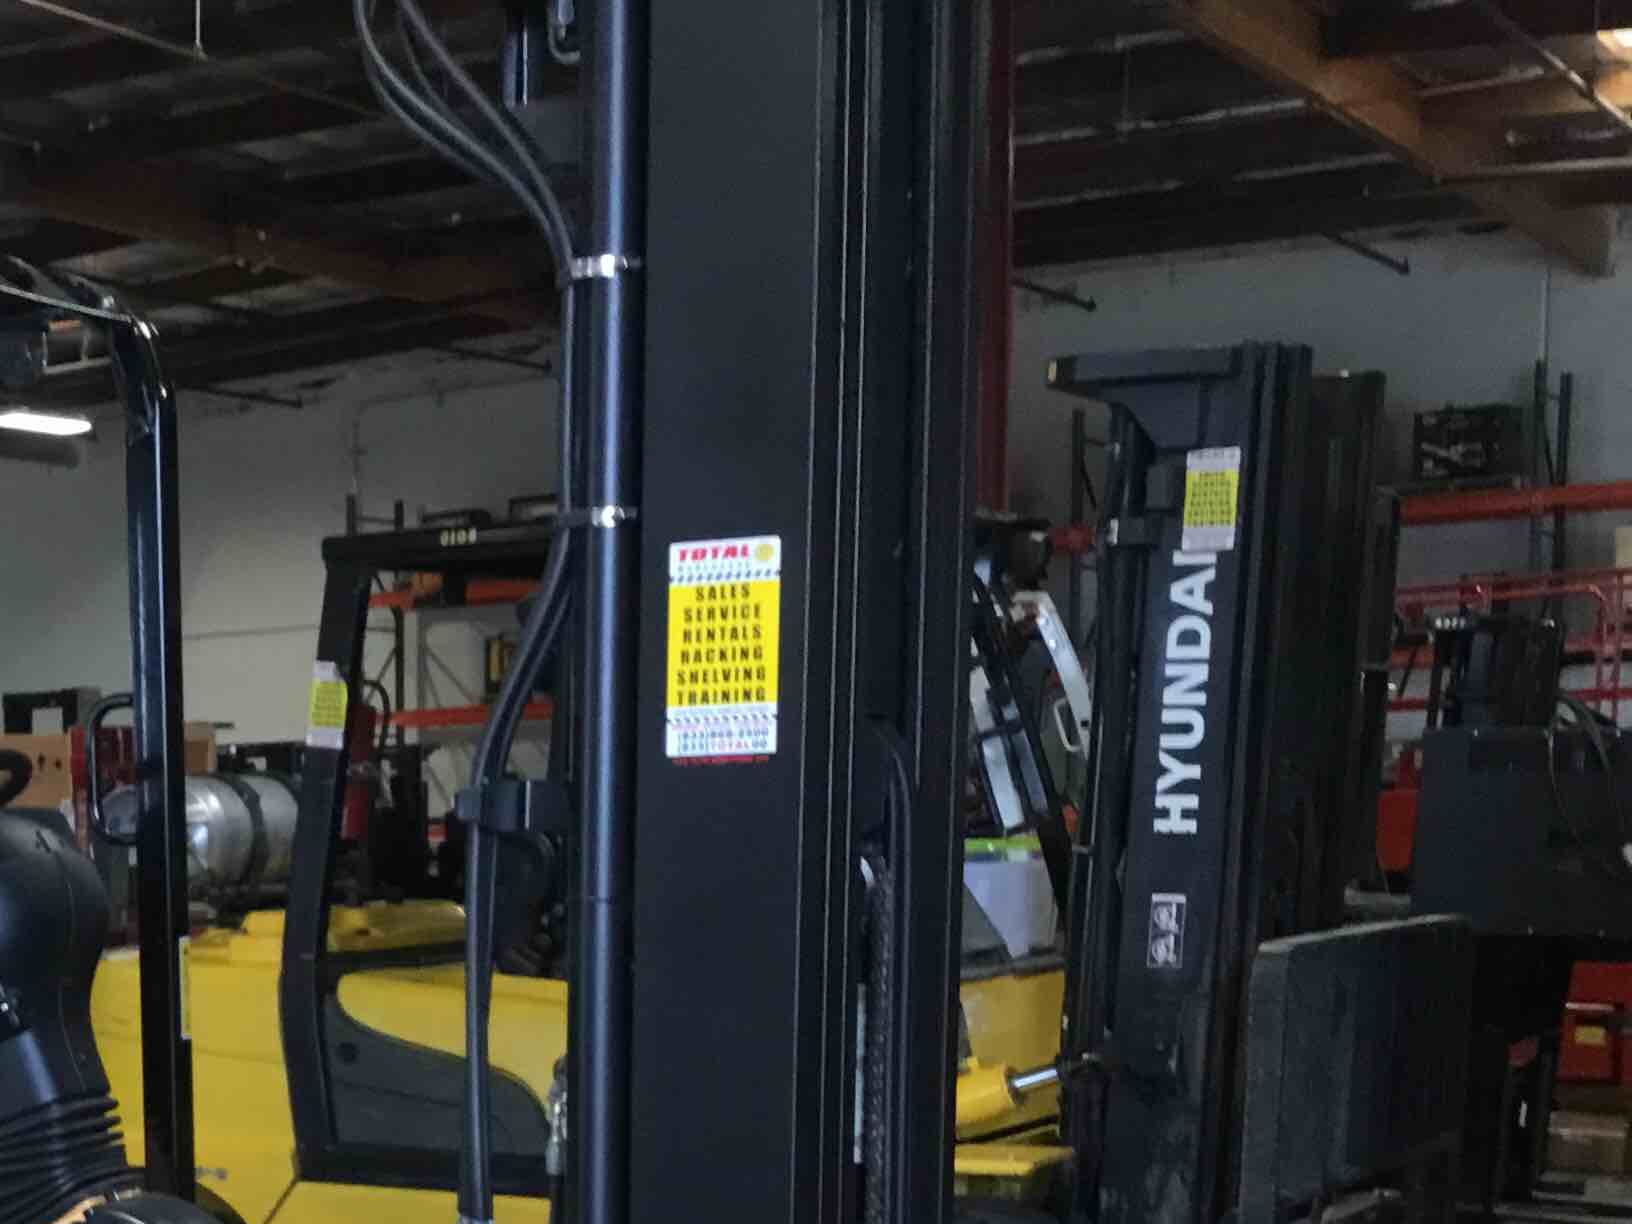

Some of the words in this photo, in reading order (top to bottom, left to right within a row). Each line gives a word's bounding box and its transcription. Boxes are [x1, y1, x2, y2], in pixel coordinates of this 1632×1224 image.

[679, 544, 751, 561] TOTAL
[695, 583, 750, 602] SALES
[683, 602, 761, 623] SERVICE
[682, 624, 762, 644] RENTALS
[680, 645, 764, 665] RACKING
[677, 665, 766, 685] SHELVING
[677, 685, 766, 707] TRAINING
[1153, 550, 1217, 834] HYUNDAI
